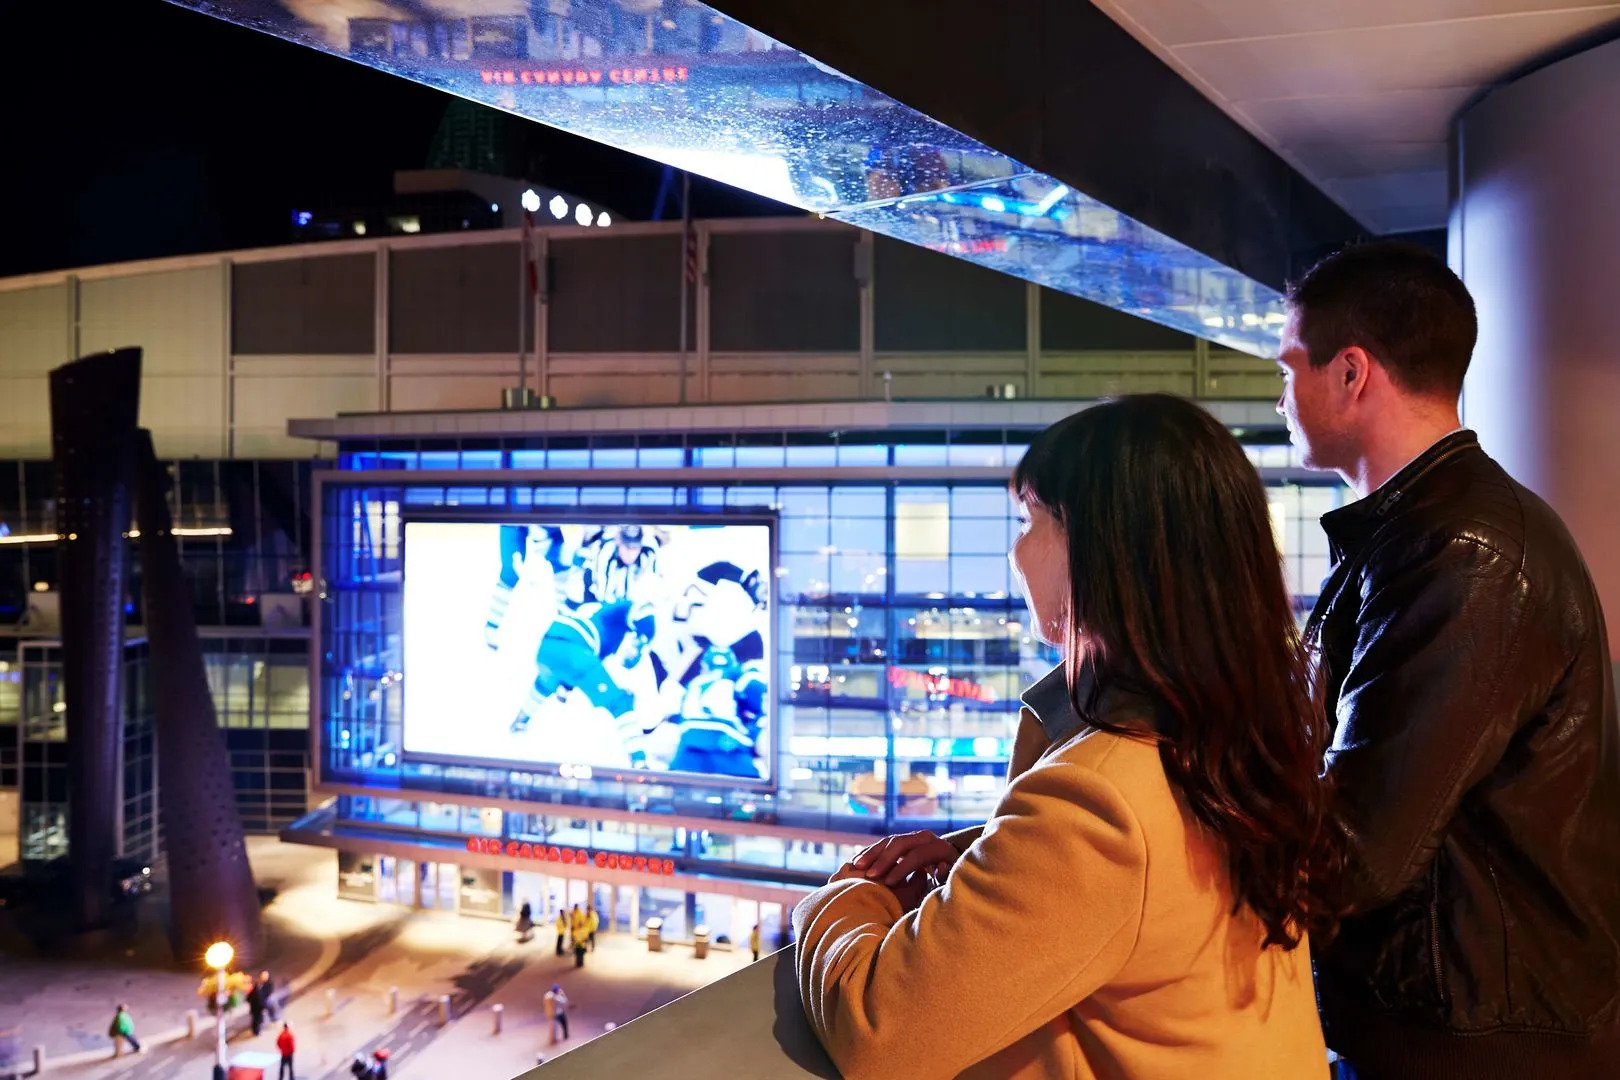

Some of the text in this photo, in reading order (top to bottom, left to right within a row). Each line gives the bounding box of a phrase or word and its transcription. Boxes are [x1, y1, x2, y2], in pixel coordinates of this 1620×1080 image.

[466, 836, 675, 876] AIR CANADA CENTRE
